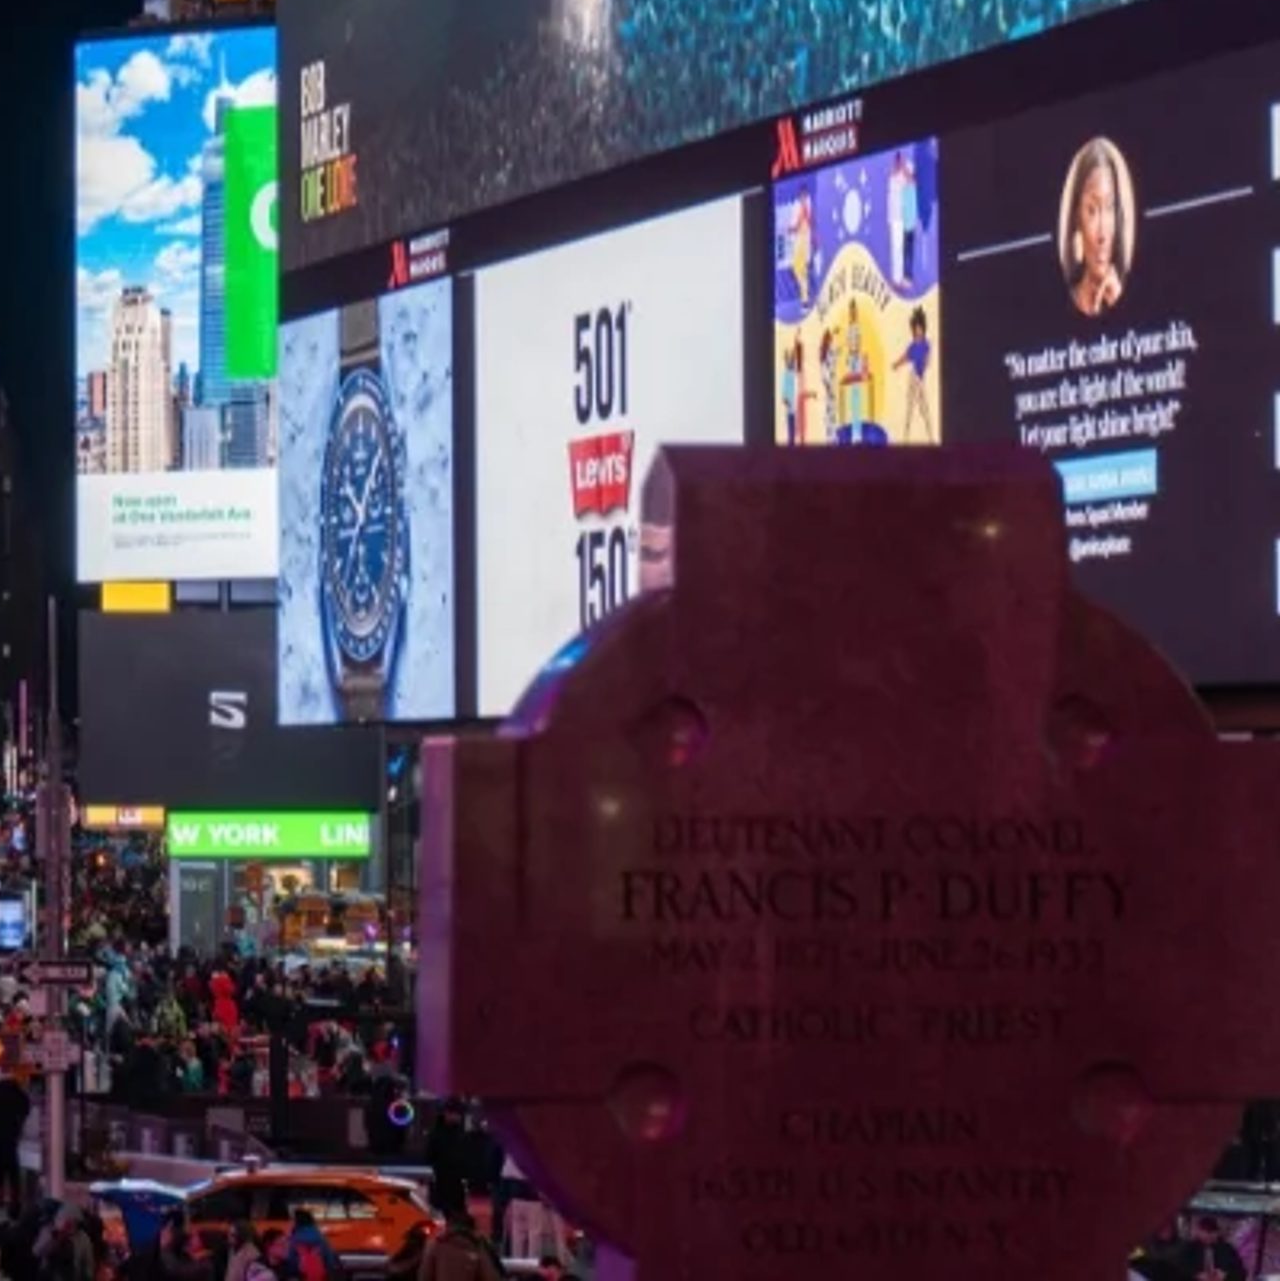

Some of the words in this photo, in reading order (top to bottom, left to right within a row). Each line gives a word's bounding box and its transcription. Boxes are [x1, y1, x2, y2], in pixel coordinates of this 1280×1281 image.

[301, 60, 325, 118] BOB
[301, 102, 351, 169] MARLEY
[803, 99, 864, 133] MARRIOTT
[803, 126, 857, 160] MARQUIS
[301, 165, 326, 223] ONE
[326, 153, 358, 214] LOVE
[573, 303, 630, 424] 501
[1027, 346, 1068, 377] matter
[1068, 339, 1087, 370] the
[1088, 333, 1118, 365] color
[1059, 376, 1078, 408] the
[1123, 367, 1144, 398] the
[207, 822, 280, 847] YORK
[621, 869, 859, 922] FRANCIS
[937, 869, 1132, 923] DUFFY
